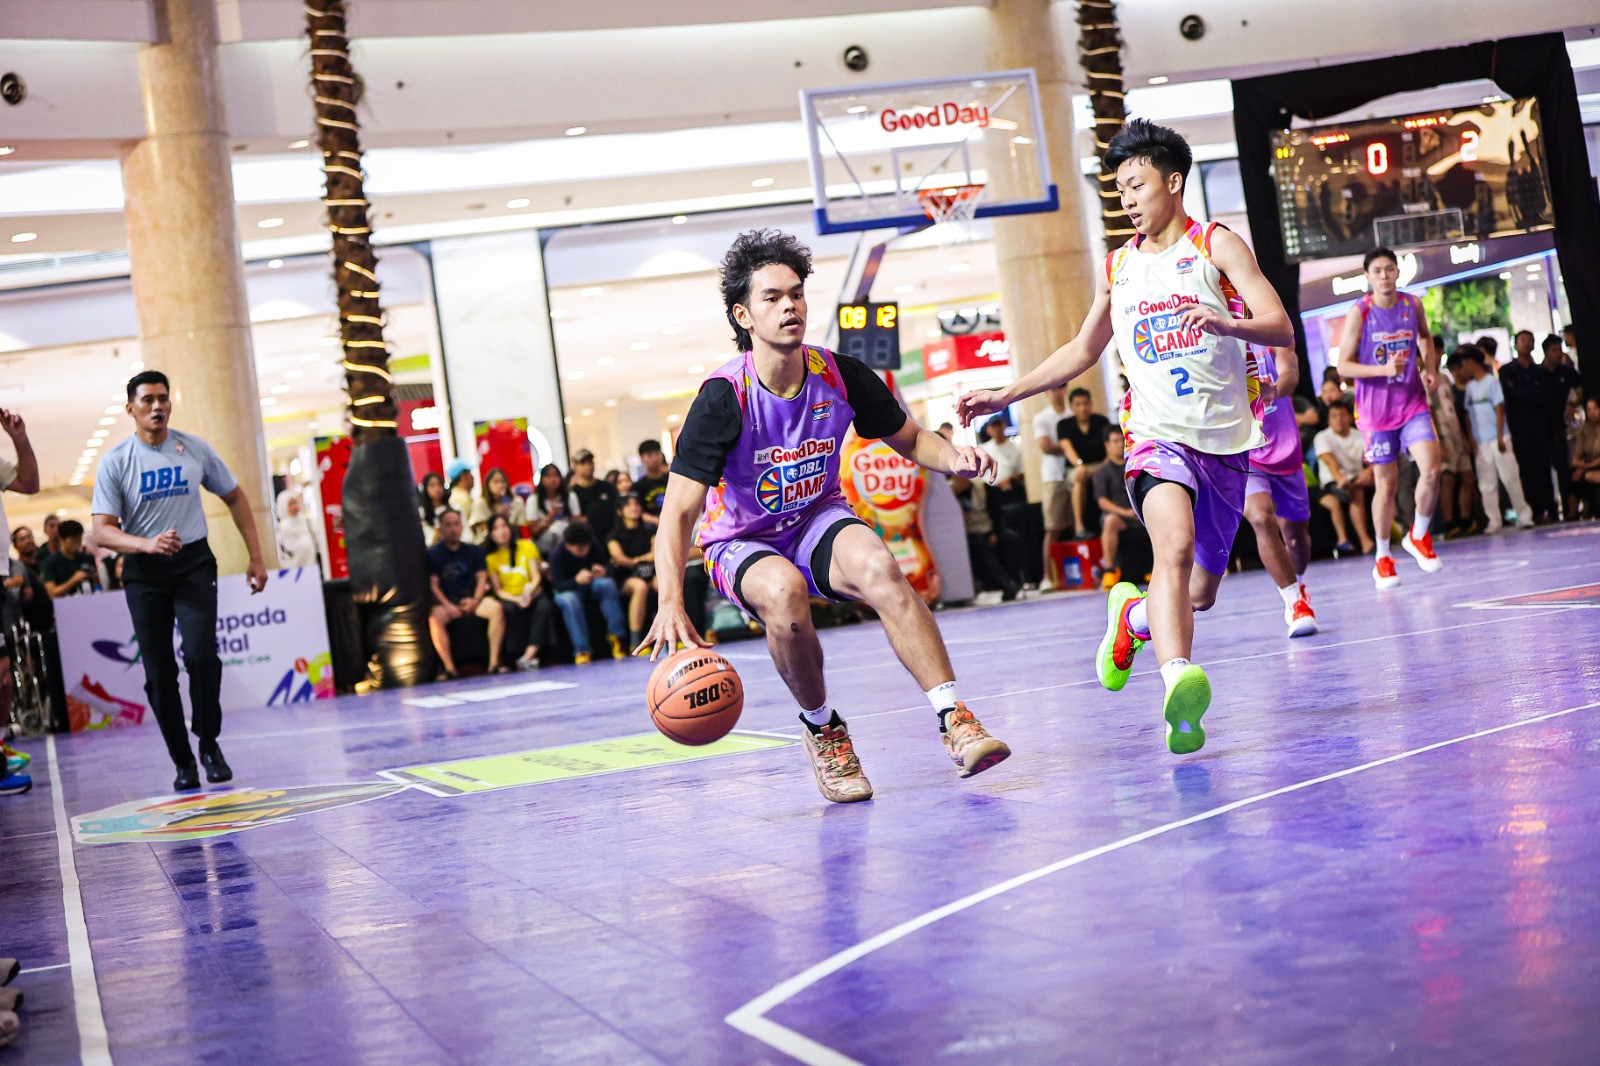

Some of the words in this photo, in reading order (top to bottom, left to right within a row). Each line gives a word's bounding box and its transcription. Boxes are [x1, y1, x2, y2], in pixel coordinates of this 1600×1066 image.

[1153, 328, 1203, 353] CAMP
[1170, 367, 1194, 397] 2
[141, 466, 189, 493] DBL
[798, 459, 822, 478] DBL
[784, 473, 827, 504] CAMP
[864, 474, 913, 497] Day
[684, 683, 720, 709] DBL
